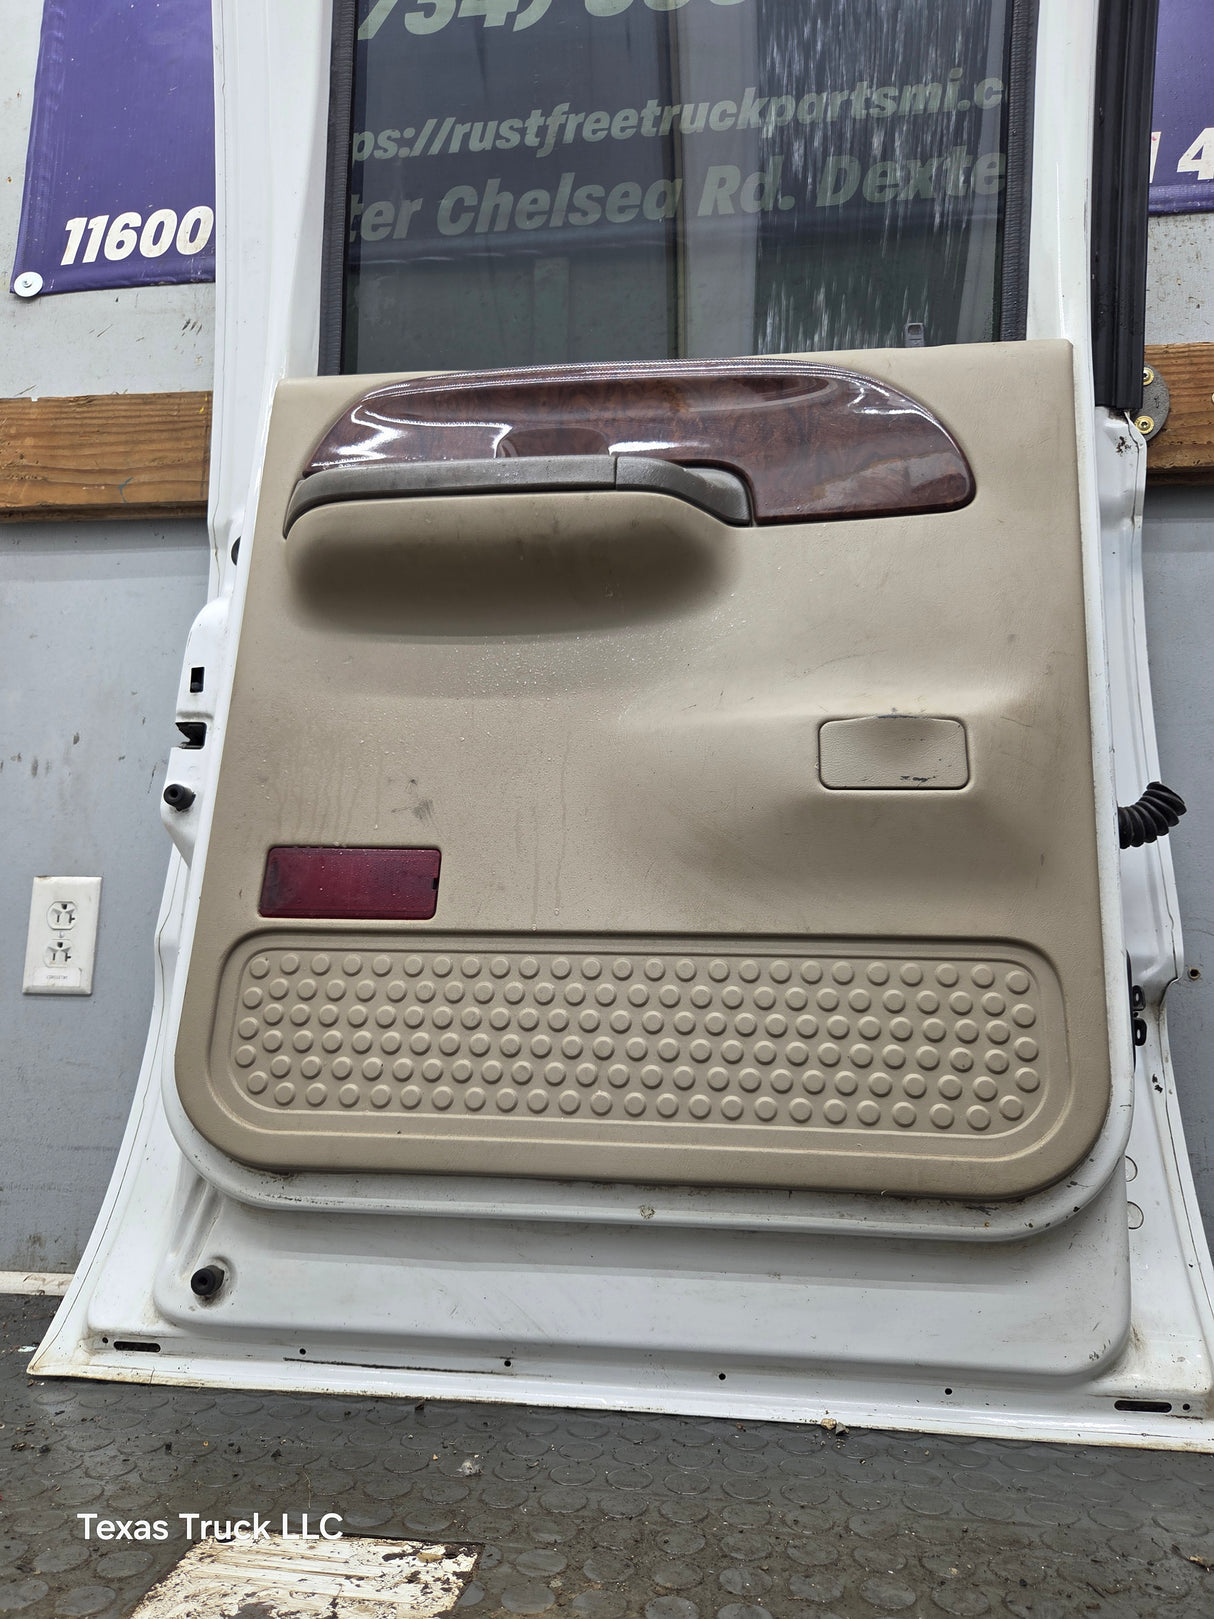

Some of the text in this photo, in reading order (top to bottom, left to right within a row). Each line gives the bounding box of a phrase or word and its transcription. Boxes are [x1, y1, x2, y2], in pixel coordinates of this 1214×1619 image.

[61, 205, 214, 265] 11600
[437, 172, 683, 236] Chelsea
[697, 155, 796, 217] Rd.
